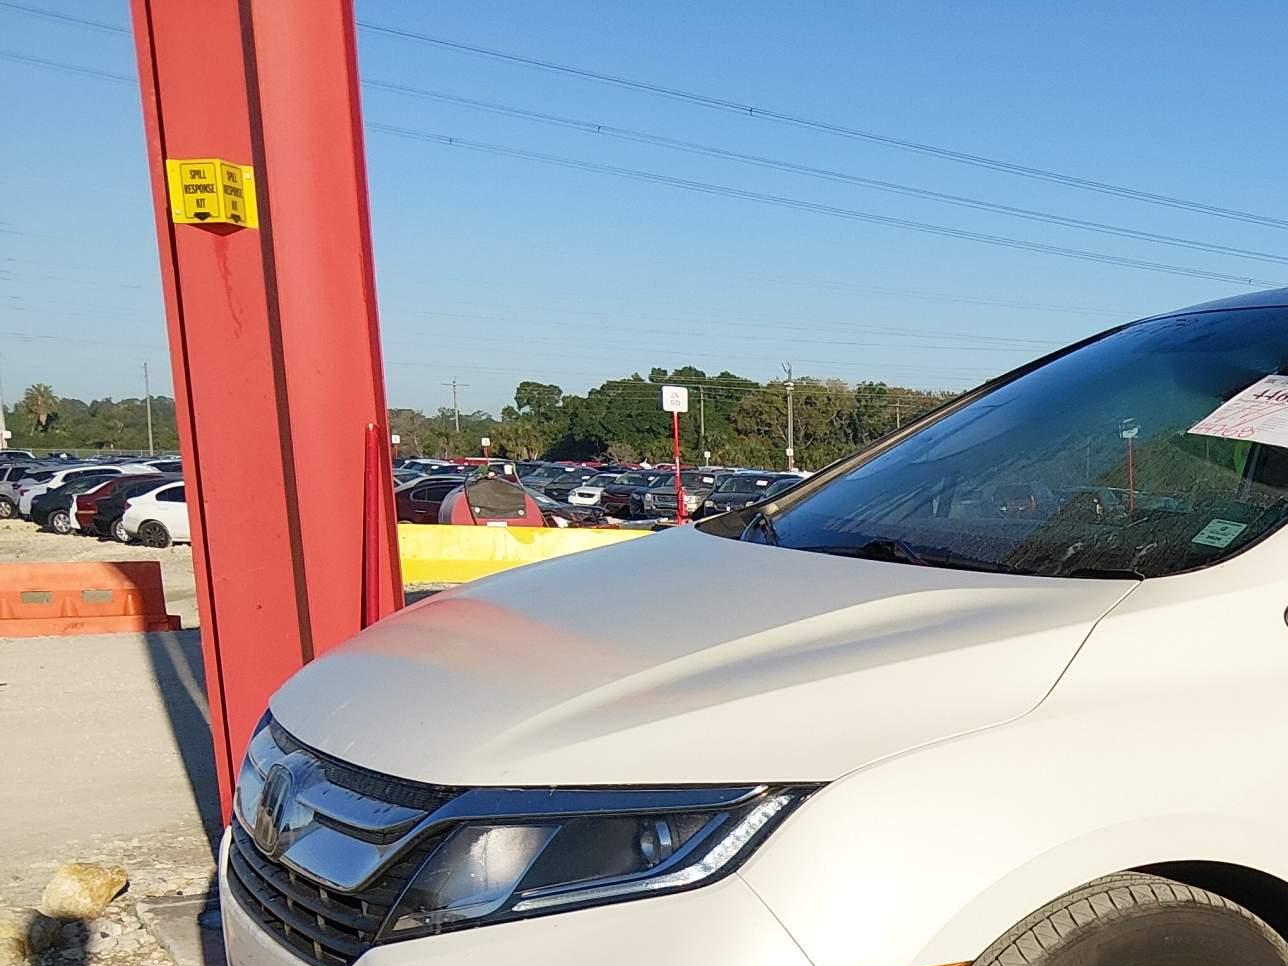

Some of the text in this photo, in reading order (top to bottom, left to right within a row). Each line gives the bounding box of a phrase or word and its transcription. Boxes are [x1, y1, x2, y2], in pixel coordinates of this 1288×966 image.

[189, 169, 207, 179] SPILL
[184, 184, 216, 194] RESPONSE
[196, 198, 206, 208] KIT
